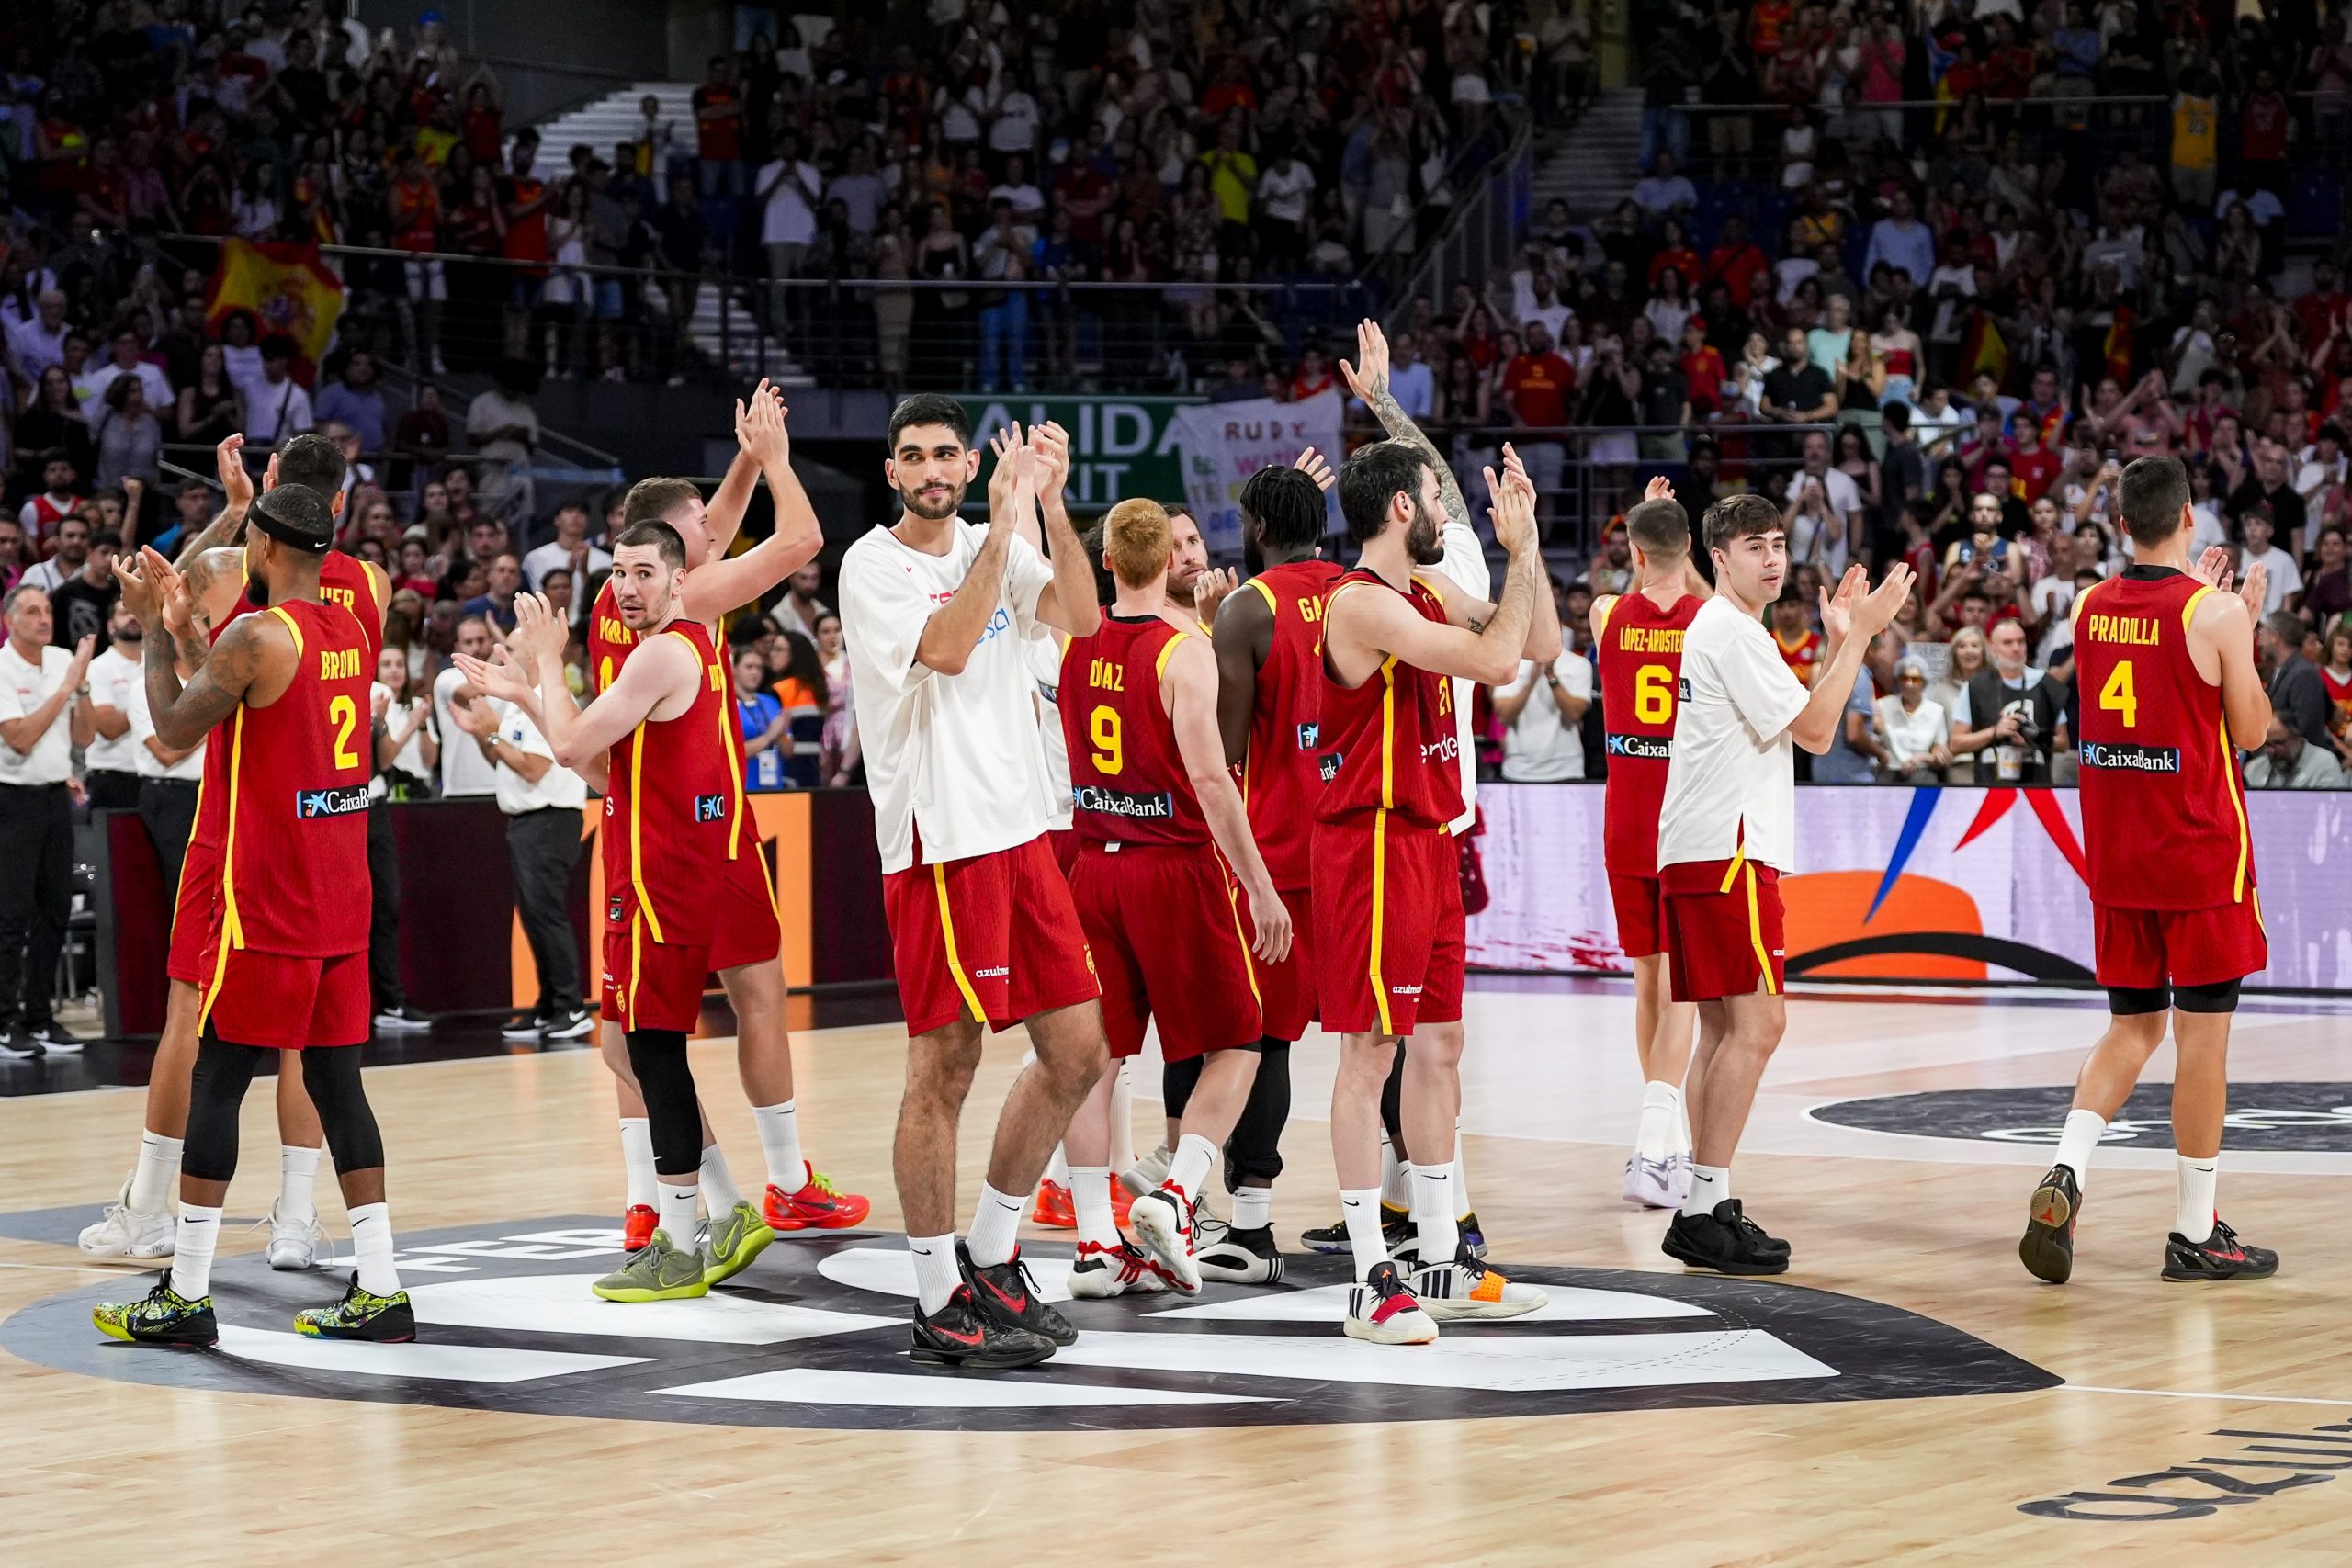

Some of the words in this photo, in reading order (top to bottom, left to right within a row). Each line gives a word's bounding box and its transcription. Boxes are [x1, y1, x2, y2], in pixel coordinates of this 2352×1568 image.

[1225, 420, 1306, 441] RUDY
[2089, 615, 2159, 645] PRADILLA
[321, 648, 360, 681] BROWN
[1090, 657, 1124, 691] DÍAZ
[1439, 676, 1452, 716] 21
[1634, 664, 1673, 725] 6
[2099, 660, 2137, 728] 4
[329, 694, 359, 770] 2
[1091, 705, 1123, 775] 9
[2096, 746, 2176, 771] CaixaBank
[1080, 788, 1167, 817] CaixaBank
